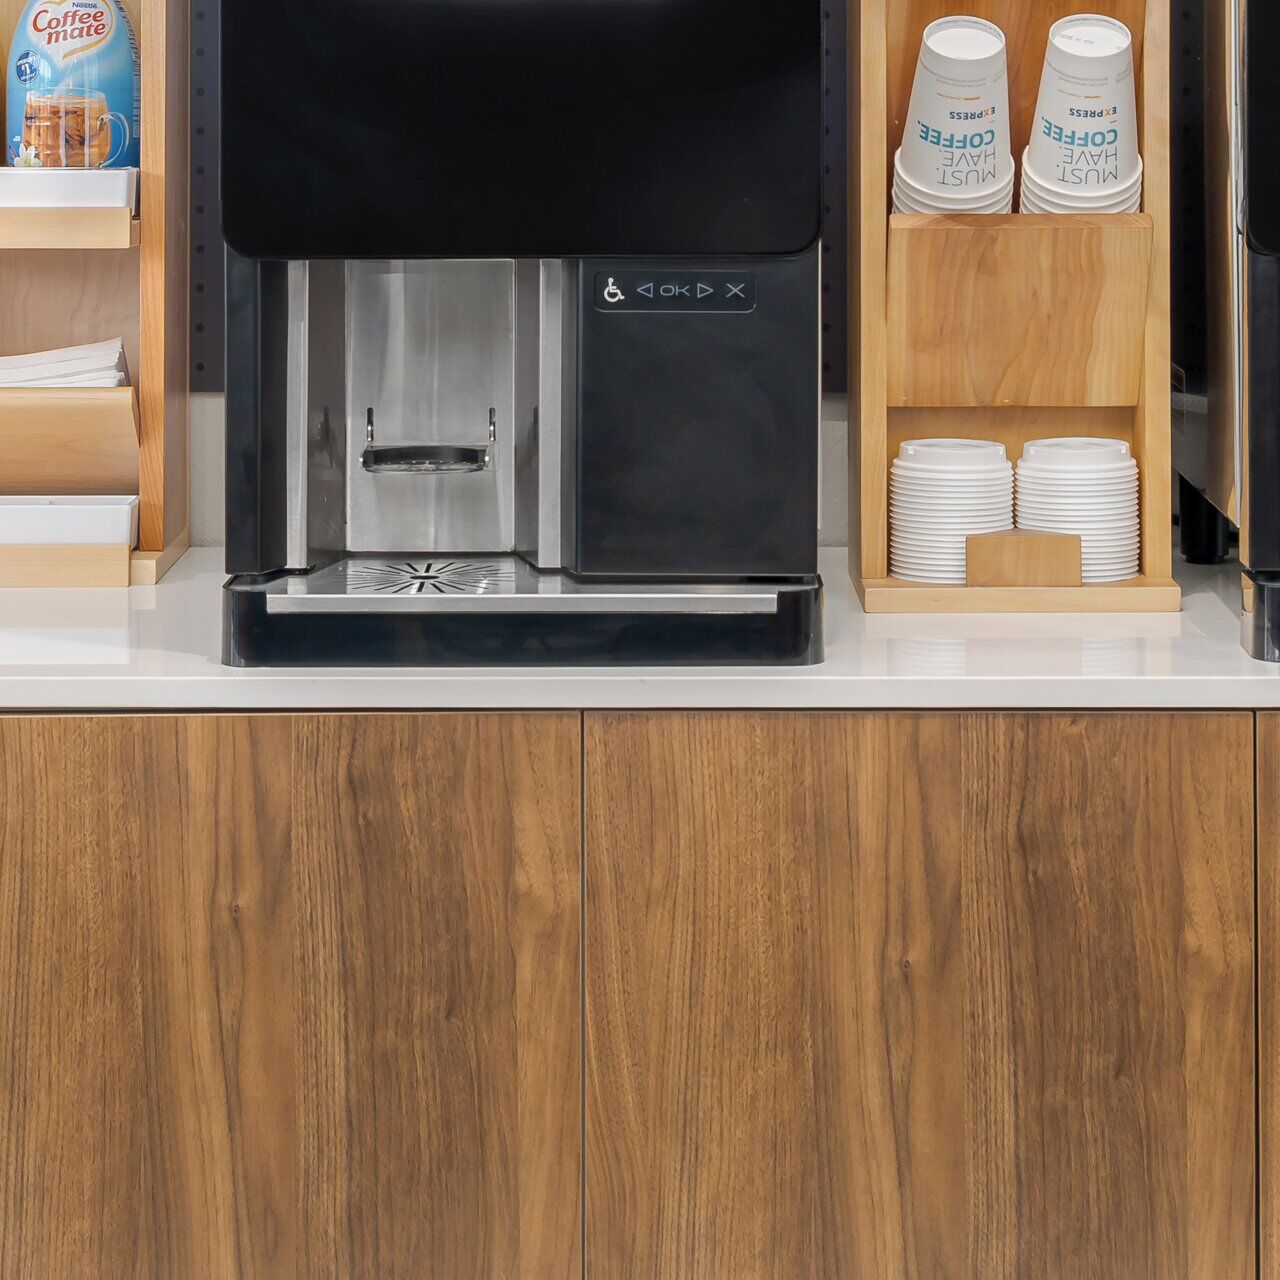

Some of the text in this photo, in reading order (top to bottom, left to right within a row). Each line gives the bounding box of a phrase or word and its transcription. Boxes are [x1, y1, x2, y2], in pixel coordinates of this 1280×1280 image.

[33, 9, 105, 33] Coffee
[46, 22, 106, 45] mate
[949, 106, 996, 120] EXPRESS
[1069, 106, 1117, 118] EXPRESS
[917, 120, 996, 149] COFFEE.
[1041, 116, 1118, 147] COFFEE.
[938, 146, 996, 167] HAVE.
[1058, 146, 1118, 165] HAVE.
[936, 165, 996, 186] MUST.
[1056, 165, 1118, 184] MUST.
[660, 285, 690, 296] OK
